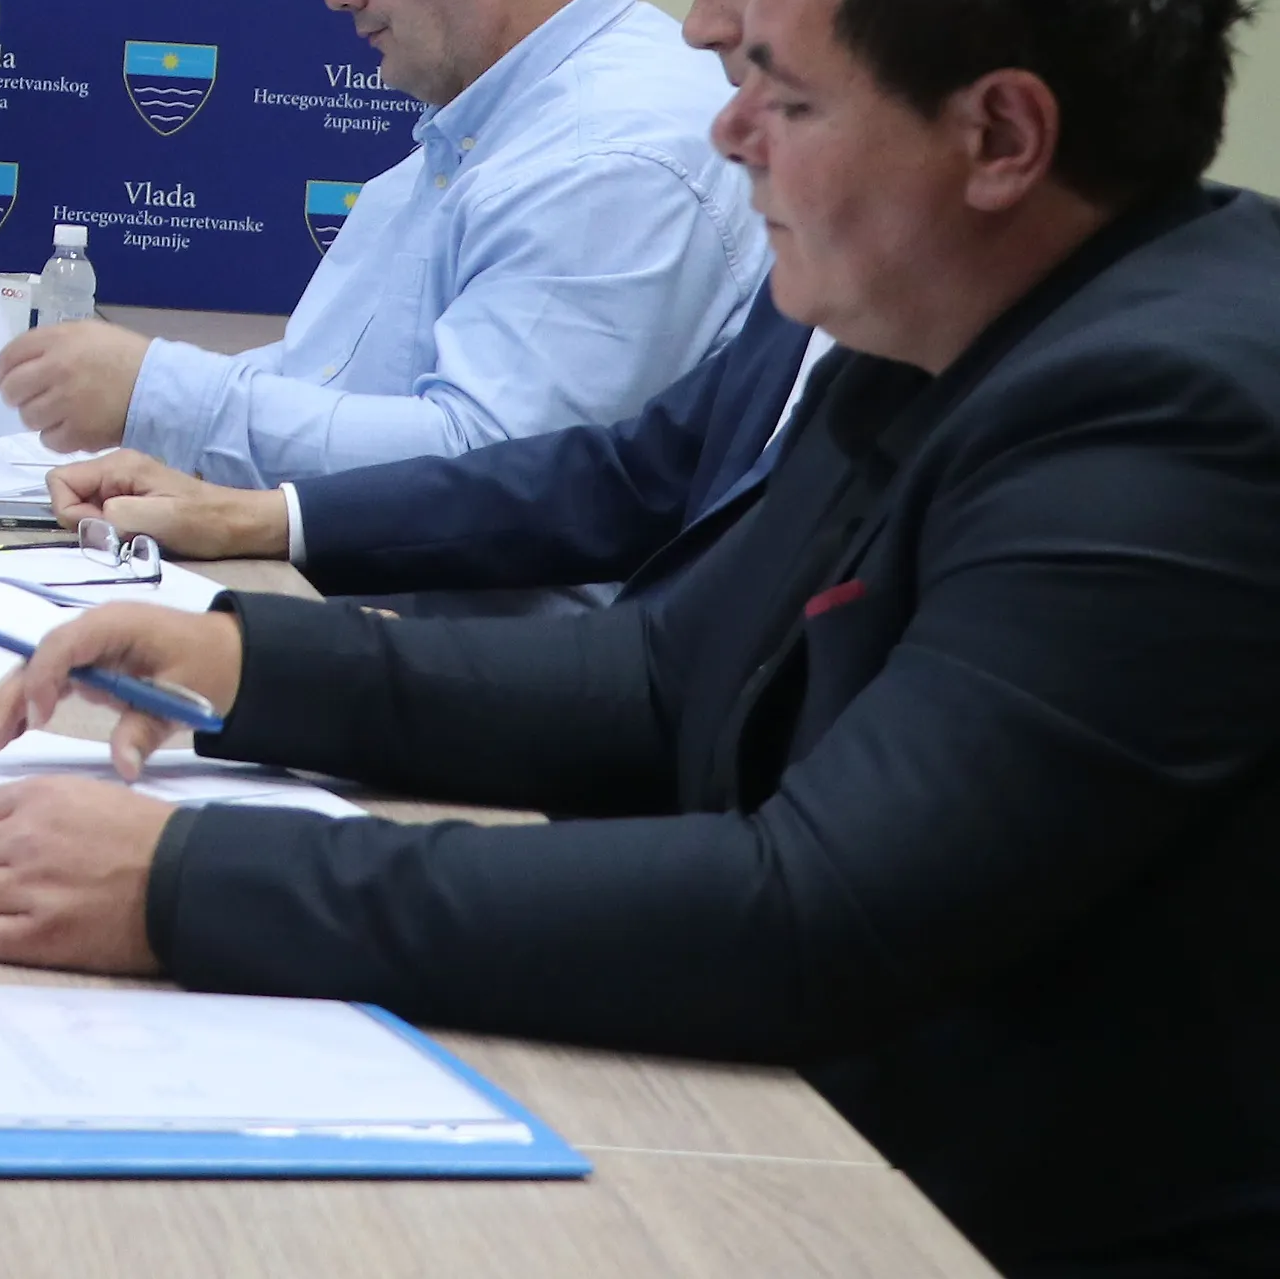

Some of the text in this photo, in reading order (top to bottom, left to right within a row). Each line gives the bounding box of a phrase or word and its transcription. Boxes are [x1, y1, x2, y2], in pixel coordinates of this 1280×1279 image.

[324, 64, 386, 90] Vlad
[254, 88, 427, 114] Hercegovačko-neretva
[324, 112, 391, 136] županije
[124, 180, 197, 208] Vlada
[54, 205, 265, 232] Hercegovačko-neretvanske
[124, 229, 191, 253] županije
